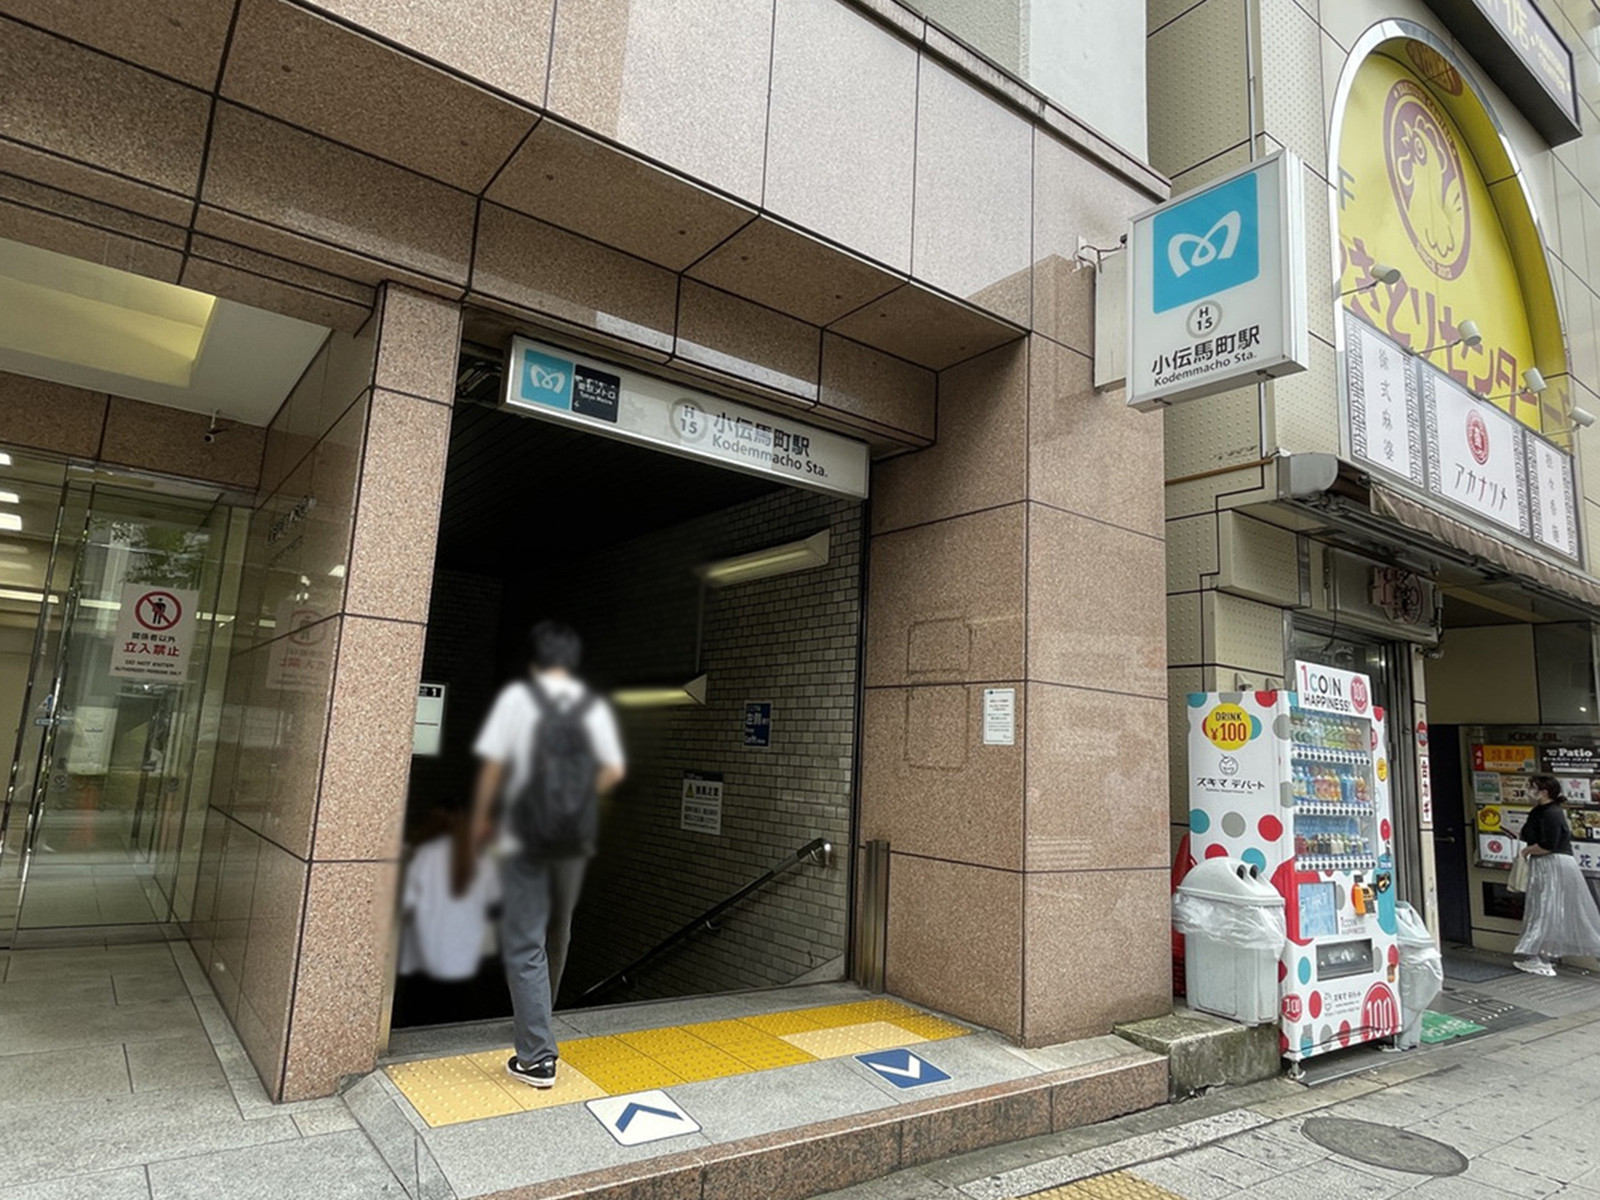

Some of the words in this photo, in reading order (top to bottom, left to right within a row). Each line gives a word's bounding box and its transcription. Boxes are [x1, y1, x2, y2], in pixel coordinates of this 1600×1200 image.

[1199, 306, 1210, 318] H
[1196, 317, 1213, 332] 15
[1151, 324, 1260, 376] 小伝馬町駅
[1154, 357, 1231, 387] Kodemmacho
[1233, 350, 1257, 364] Sta.
[684, 404, 696, 419] H
[679, 418, 699, 435] 15
[712, 411, 811, 458] 小伝馬町駅
[711, 433, 803, 471] Kodemmacho
[805, 460, 829, 478] Sta.
[124, 642, 180, 657] 立入禁止
[1215, 712, 1243, 722] DRINK
[1210, 722, 1247, 741] ¥100
[1558, 747, 1593, 758] Patio
[1366, 996, 1393, 1040] 100
